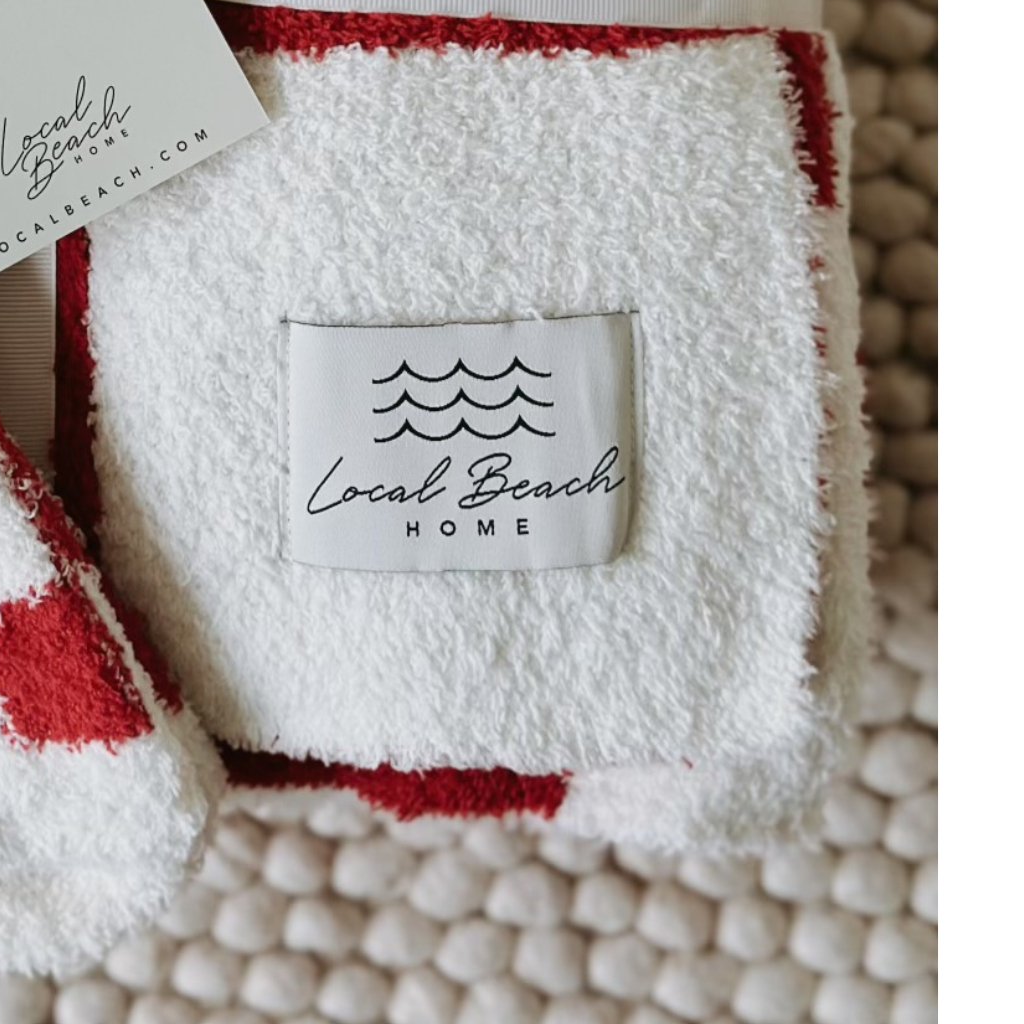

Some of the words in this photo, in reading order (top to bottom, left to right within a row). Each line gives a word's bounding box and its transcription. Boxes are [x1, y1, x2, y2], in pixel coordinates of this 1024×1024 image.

[0, 75, 93, 177] Local
[21, 85, 131, 201] Beach
[74, 128, 129, 164] HOME
[307, 455, 452, 515] Local
[457, 445, 626, 510] Beach
[406, 518, 530, 537] HOME
